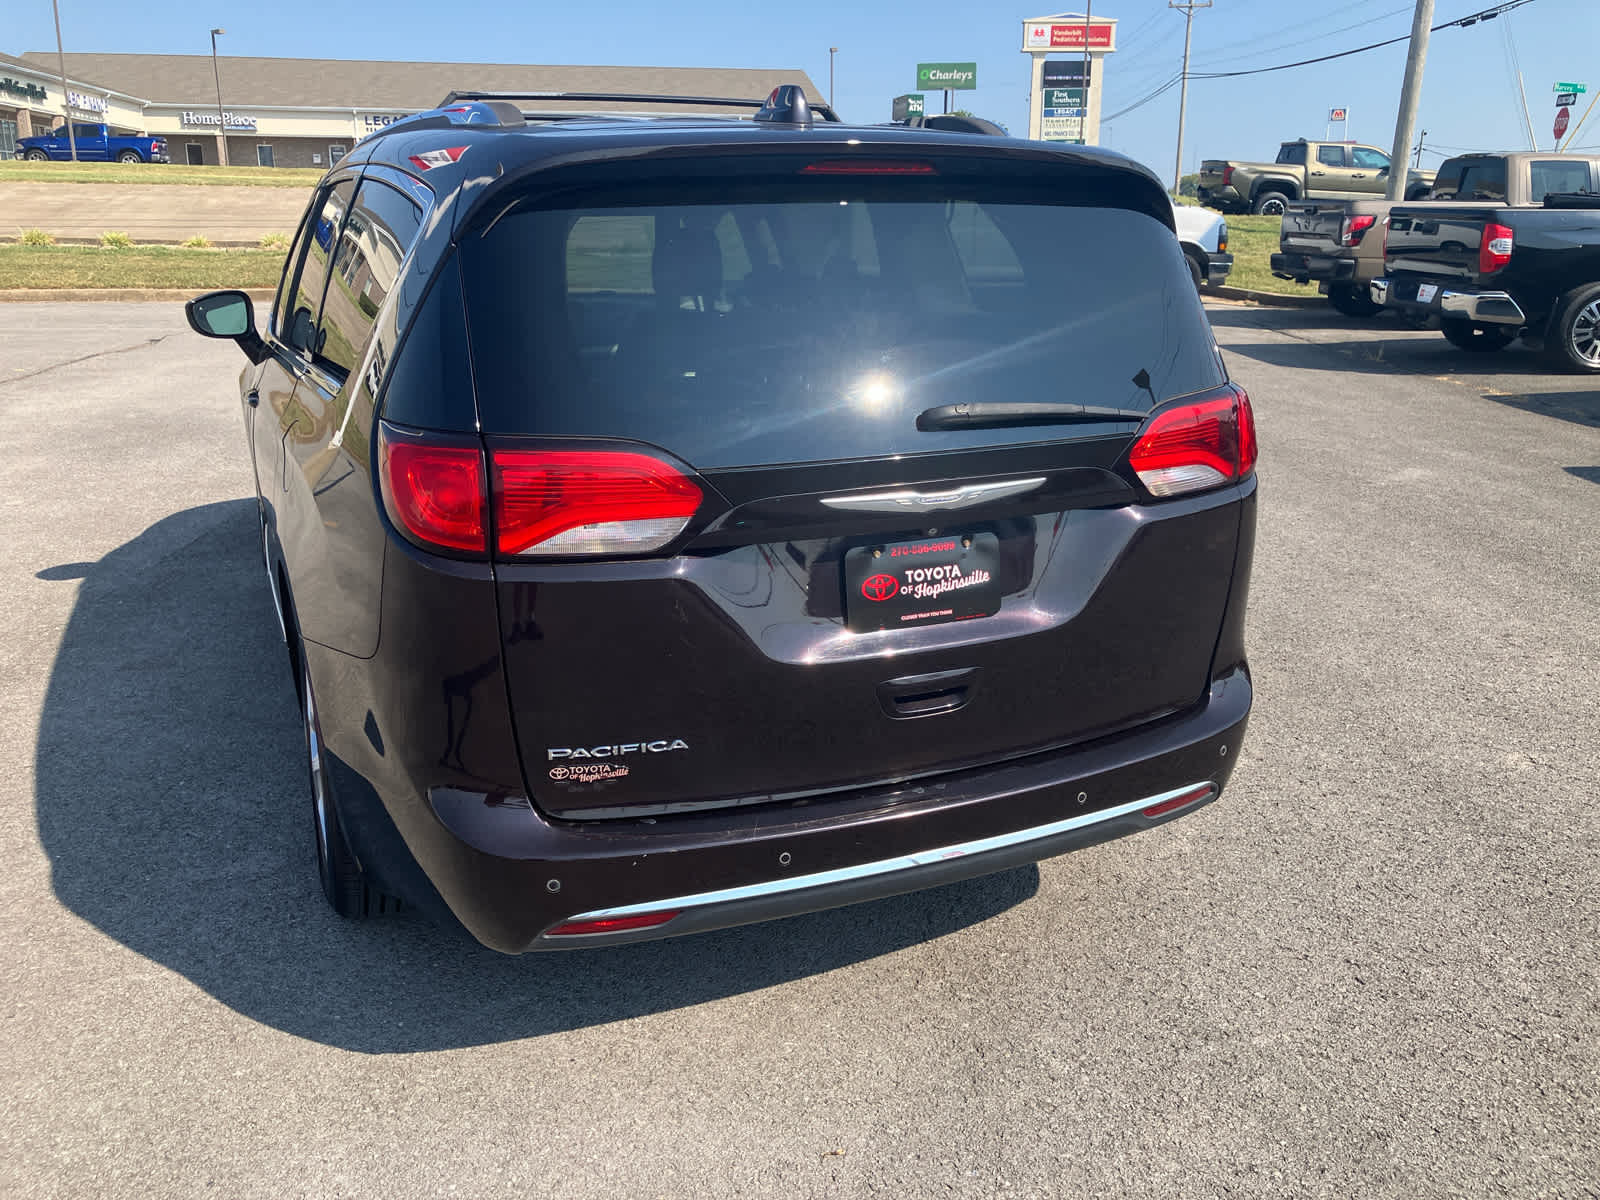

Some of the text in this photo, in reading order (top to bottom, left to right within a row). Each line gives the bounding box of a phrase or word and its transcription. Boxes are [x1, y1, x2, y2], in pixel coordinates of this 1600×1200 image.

[182, 111, 257, 125] HomePlace
[904, 564, 962, 583] TOYOTA
[900, 569, 991, 599] OF Hopkinsville
[547, 739, 689, 761] PACIFICA
[569, 765, 611, 774] TOYOTA
[578, 767, 629, 783] Hopkinsville
